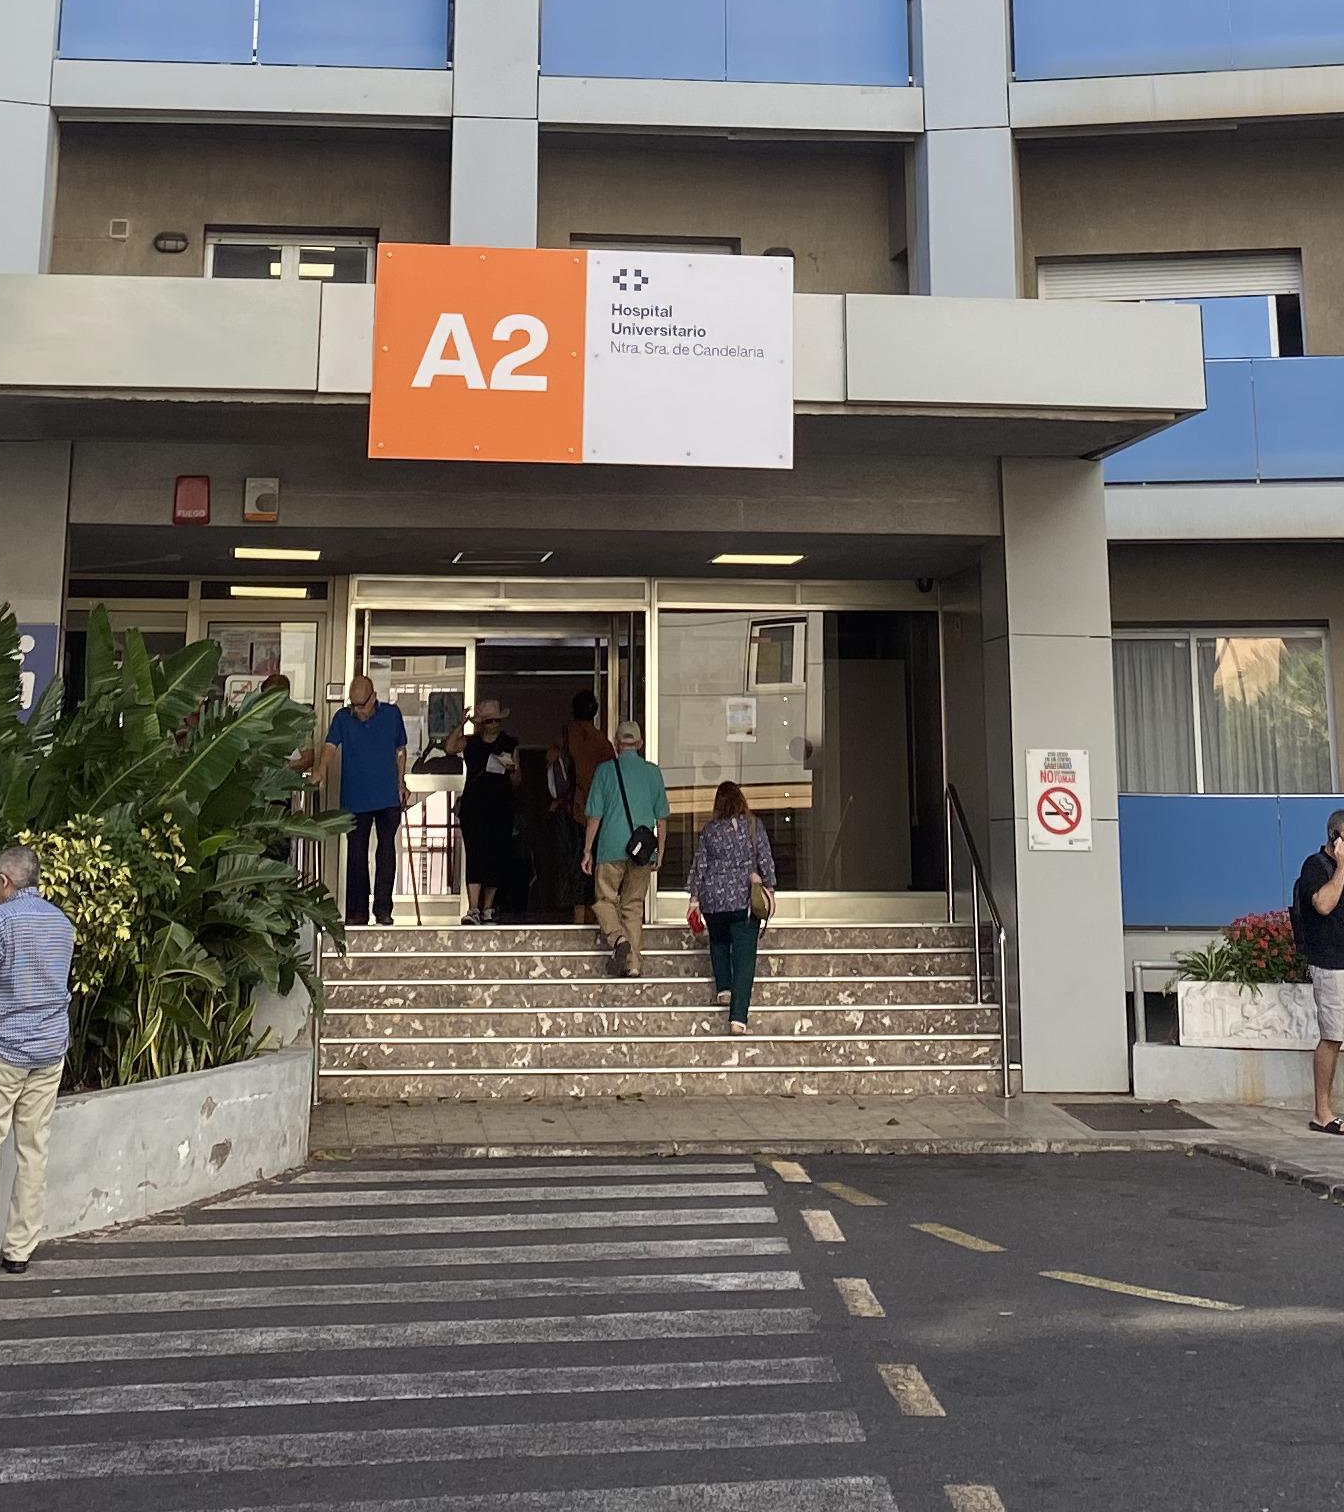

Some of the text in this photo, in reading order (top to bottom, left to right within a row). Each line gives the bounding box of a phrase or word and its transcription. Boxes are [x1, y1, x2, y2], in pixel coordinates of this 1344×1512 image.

[611, 303, 673, 319] Hospital
[611, 322, 707, 338] Universitario
[411, 312, 550, 392] A2
[644, 342, 669, 355] Sra.
[672, 344, 690, 356] de
[693, 344, 765, 359] Candelaria
[176, 510, 206, 518] FUEGO
[1040, 770, 1054, 783] NO
